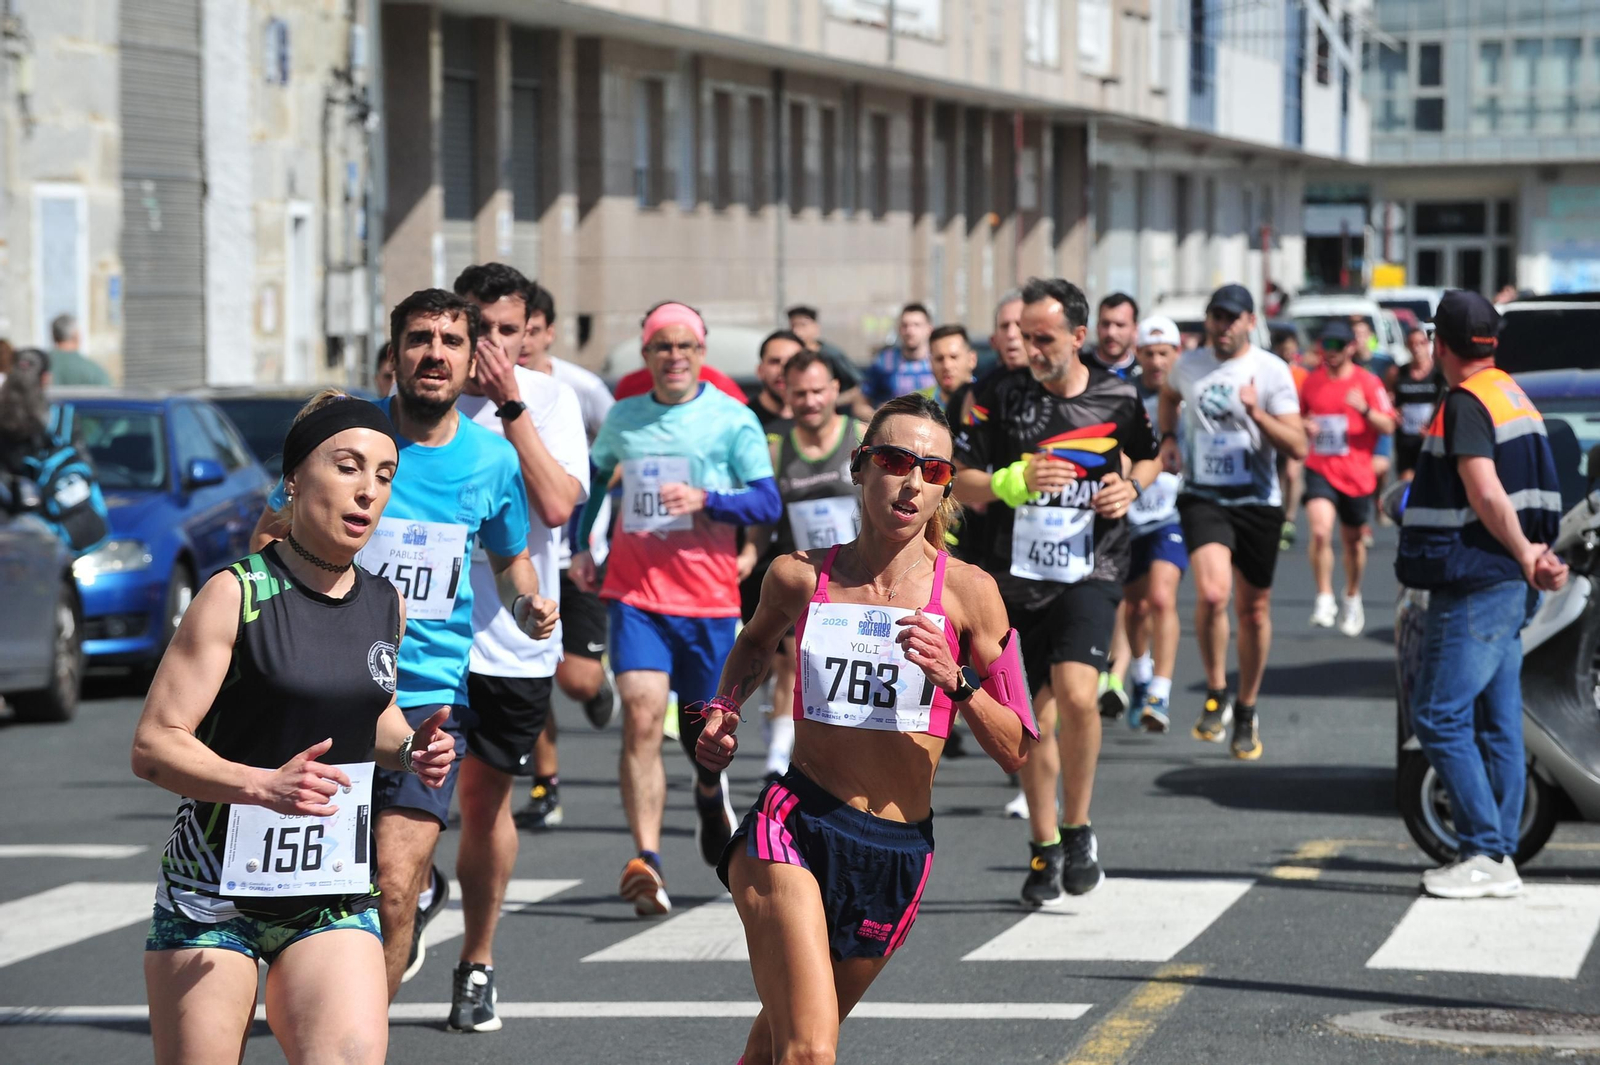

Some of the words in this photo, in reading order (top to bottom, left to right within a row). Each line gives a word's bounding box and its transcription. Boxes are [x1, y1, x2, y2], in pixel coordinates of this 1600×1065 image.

[389, 549, 424, 561] PABLIS
[1029, 541, 1070, 567] 439
[822, 617, 849, 627] 2026
[850, 642, 881, 655] YOLI
[825, 656, 900, 708] 763
[821, 712, 841, 720] OURENSE
[261, 824, 325, 873] 156
[862, 919, 882, 930] BMW
